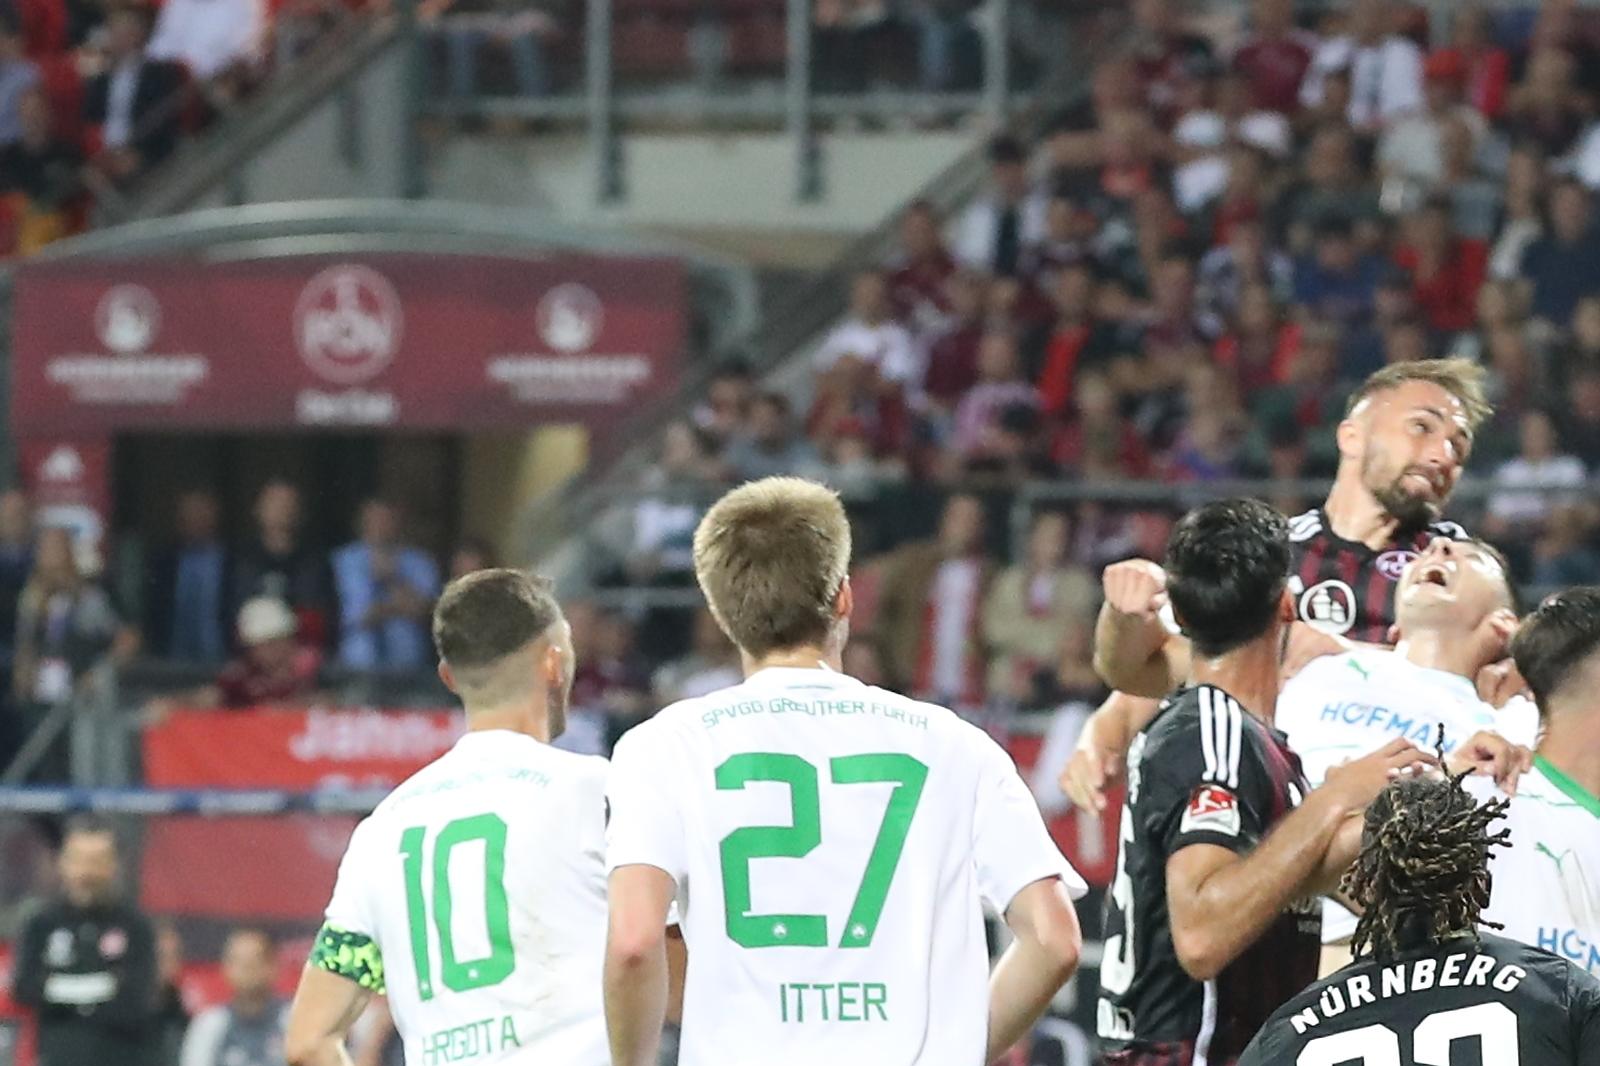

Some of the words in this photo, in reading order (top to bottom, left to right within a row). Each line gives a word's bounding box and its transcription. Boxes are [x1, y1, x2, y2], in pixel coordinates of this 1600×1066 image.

[714, 752, 929, 949] 27
[399, 812, 515, 1002] 10
[780, 982, 888, 1022] ITTER
[1290, 953, 1526, 1034] NÜRNBERG
[422, 1015, 521, 1066] HRGOTA
